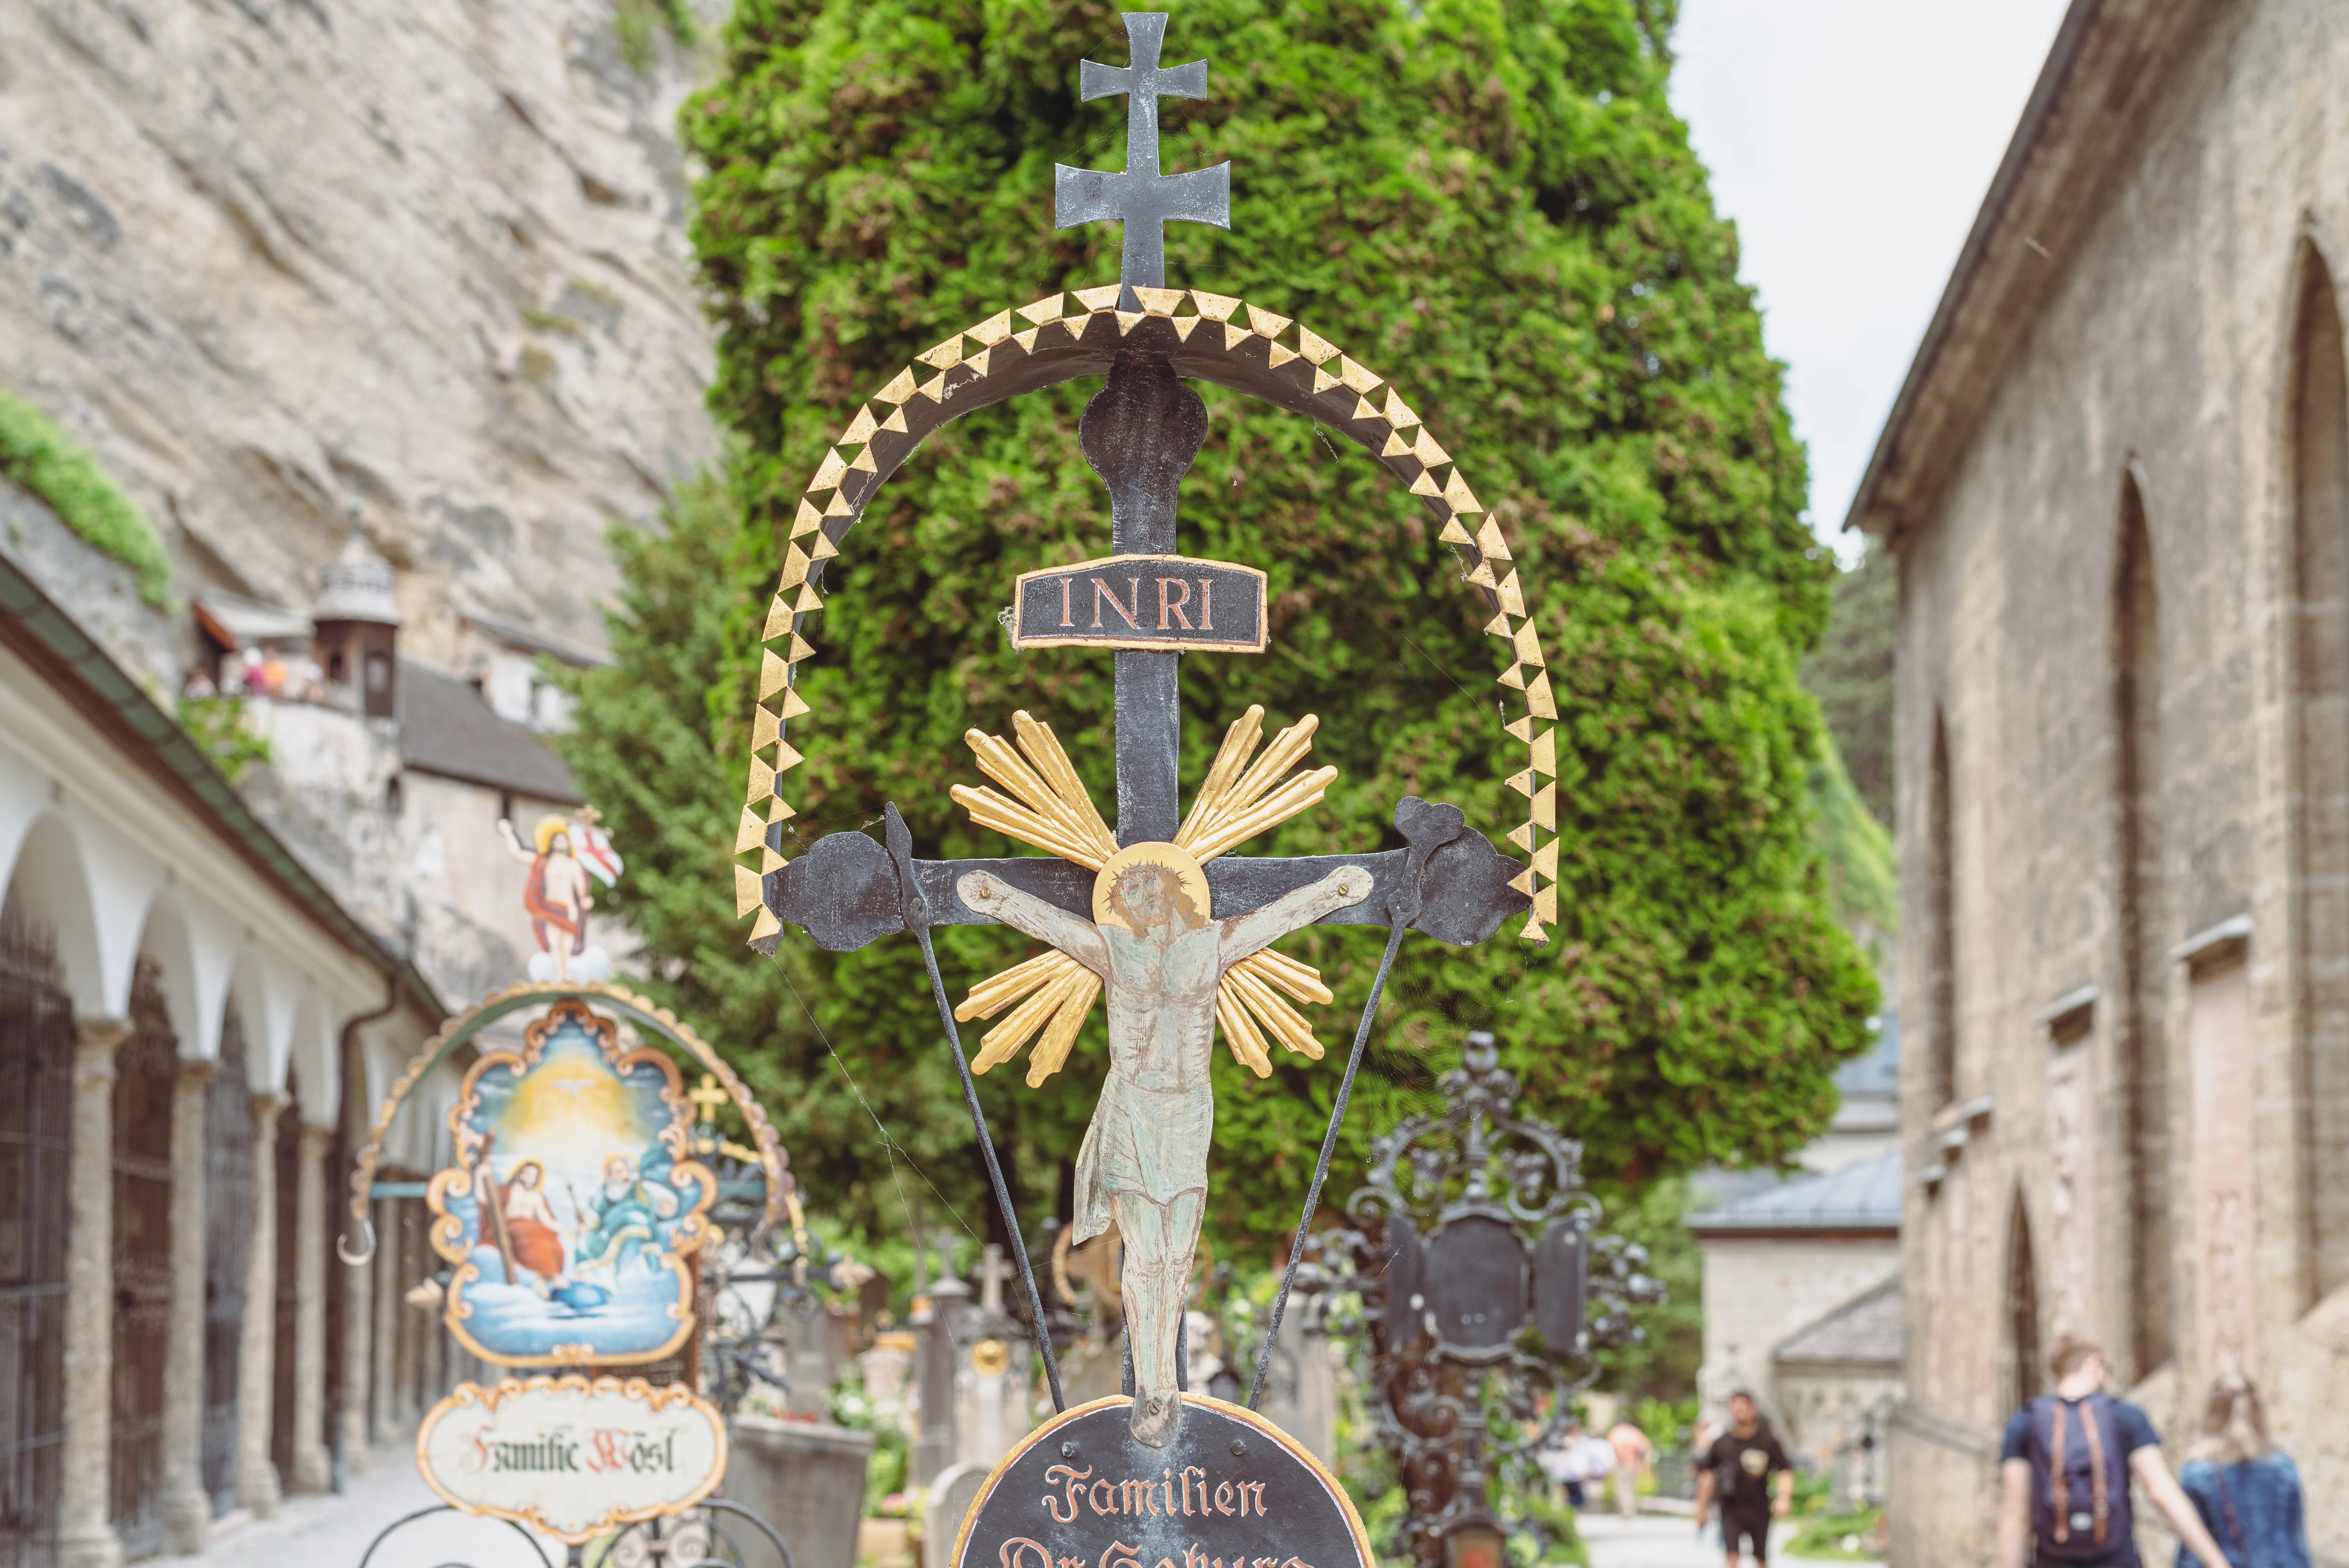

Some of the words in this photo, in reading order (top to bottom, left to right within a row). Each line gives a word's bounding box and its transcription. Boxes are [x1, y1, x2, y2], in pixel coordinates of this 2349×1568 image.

[1059, 577, 1214, 630] INRI
[457, 1423, 579, 1473] Familie
[1041, 1464, 1268, 1523] Familien
